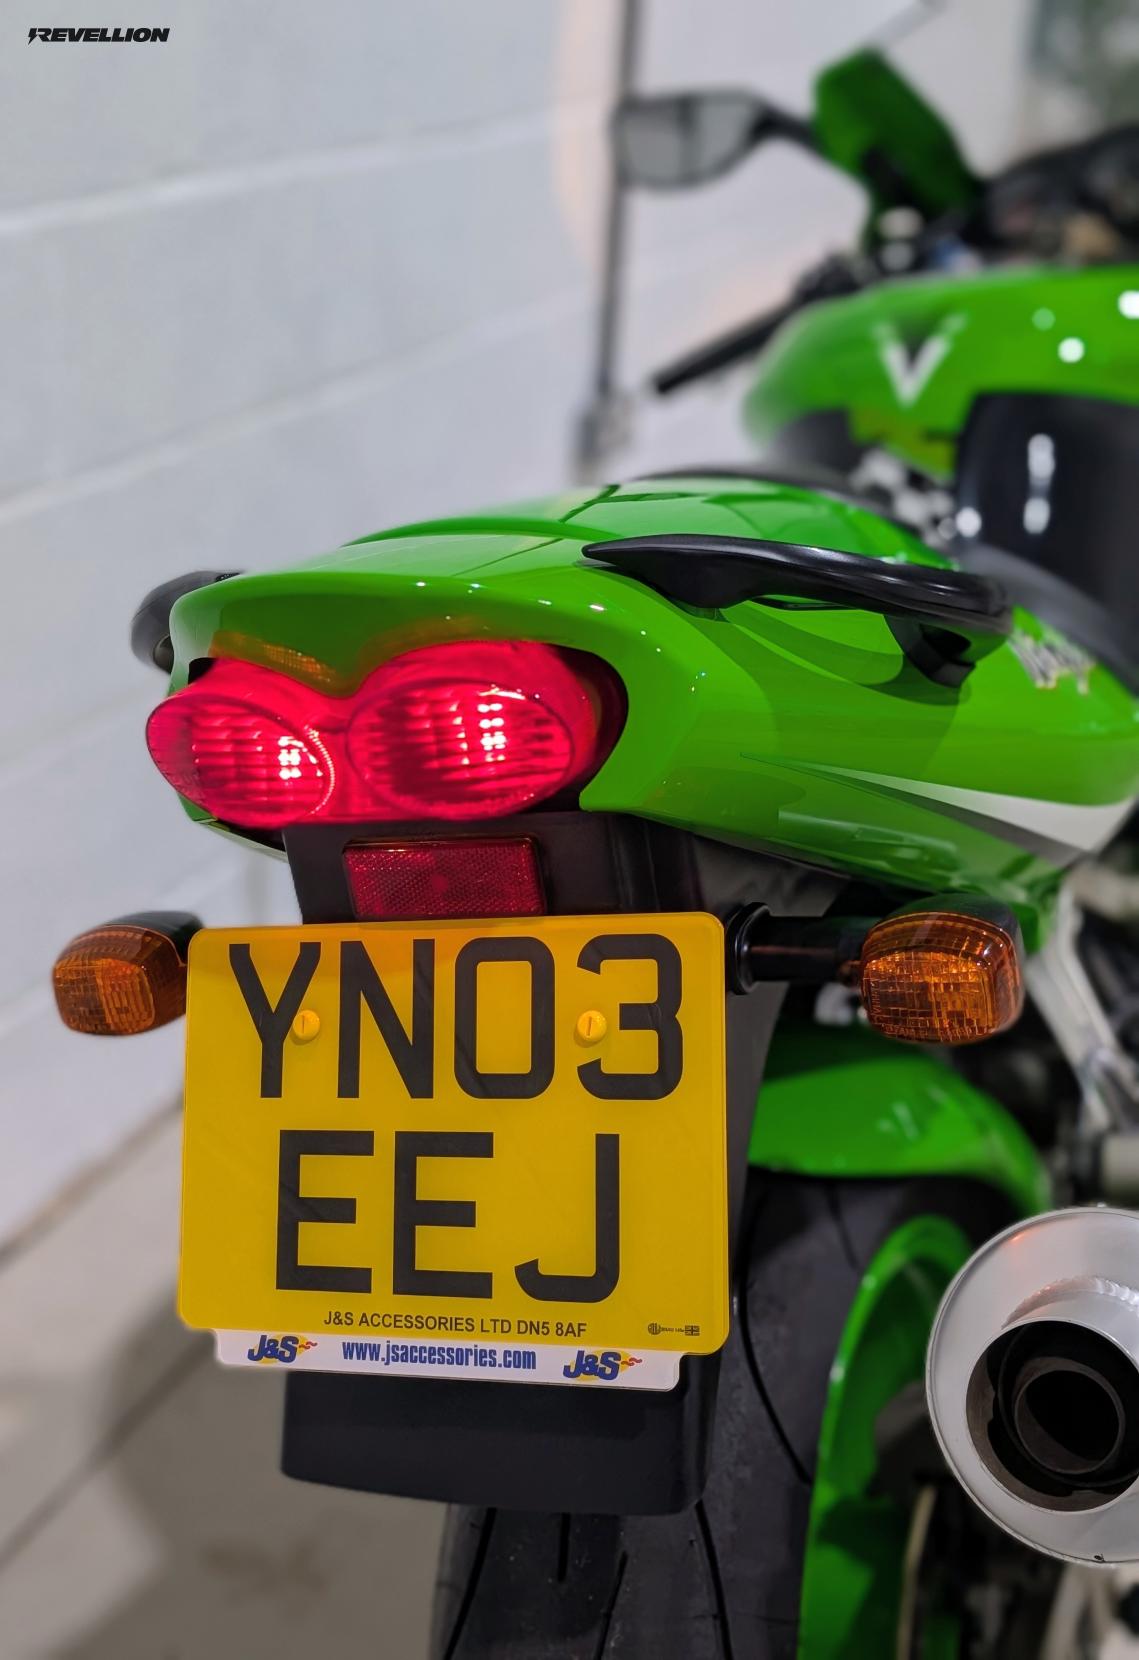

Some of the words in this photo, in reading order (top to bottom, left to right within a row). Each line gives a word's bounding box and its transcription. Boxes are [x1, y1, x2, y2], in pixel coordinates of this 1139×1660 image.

[229, 933, 683, 1100] YN03
[276, 1129, 620, 1303] EEJ
[324, 1311, 354, 1327] J&S
[358, 1312, 475, 1332] ACCESSORIES
[481, 1318, 512, 1334] LTD
[517, 1319, 550, 1336] DN5
[555, 1321, 587, 1338] 8AF
[247, 1335, 299, 1363] J&S
[342, 1340, 536, 1370] www.jsaccessories.com
[563, 1350, 622, 1380] J&S
